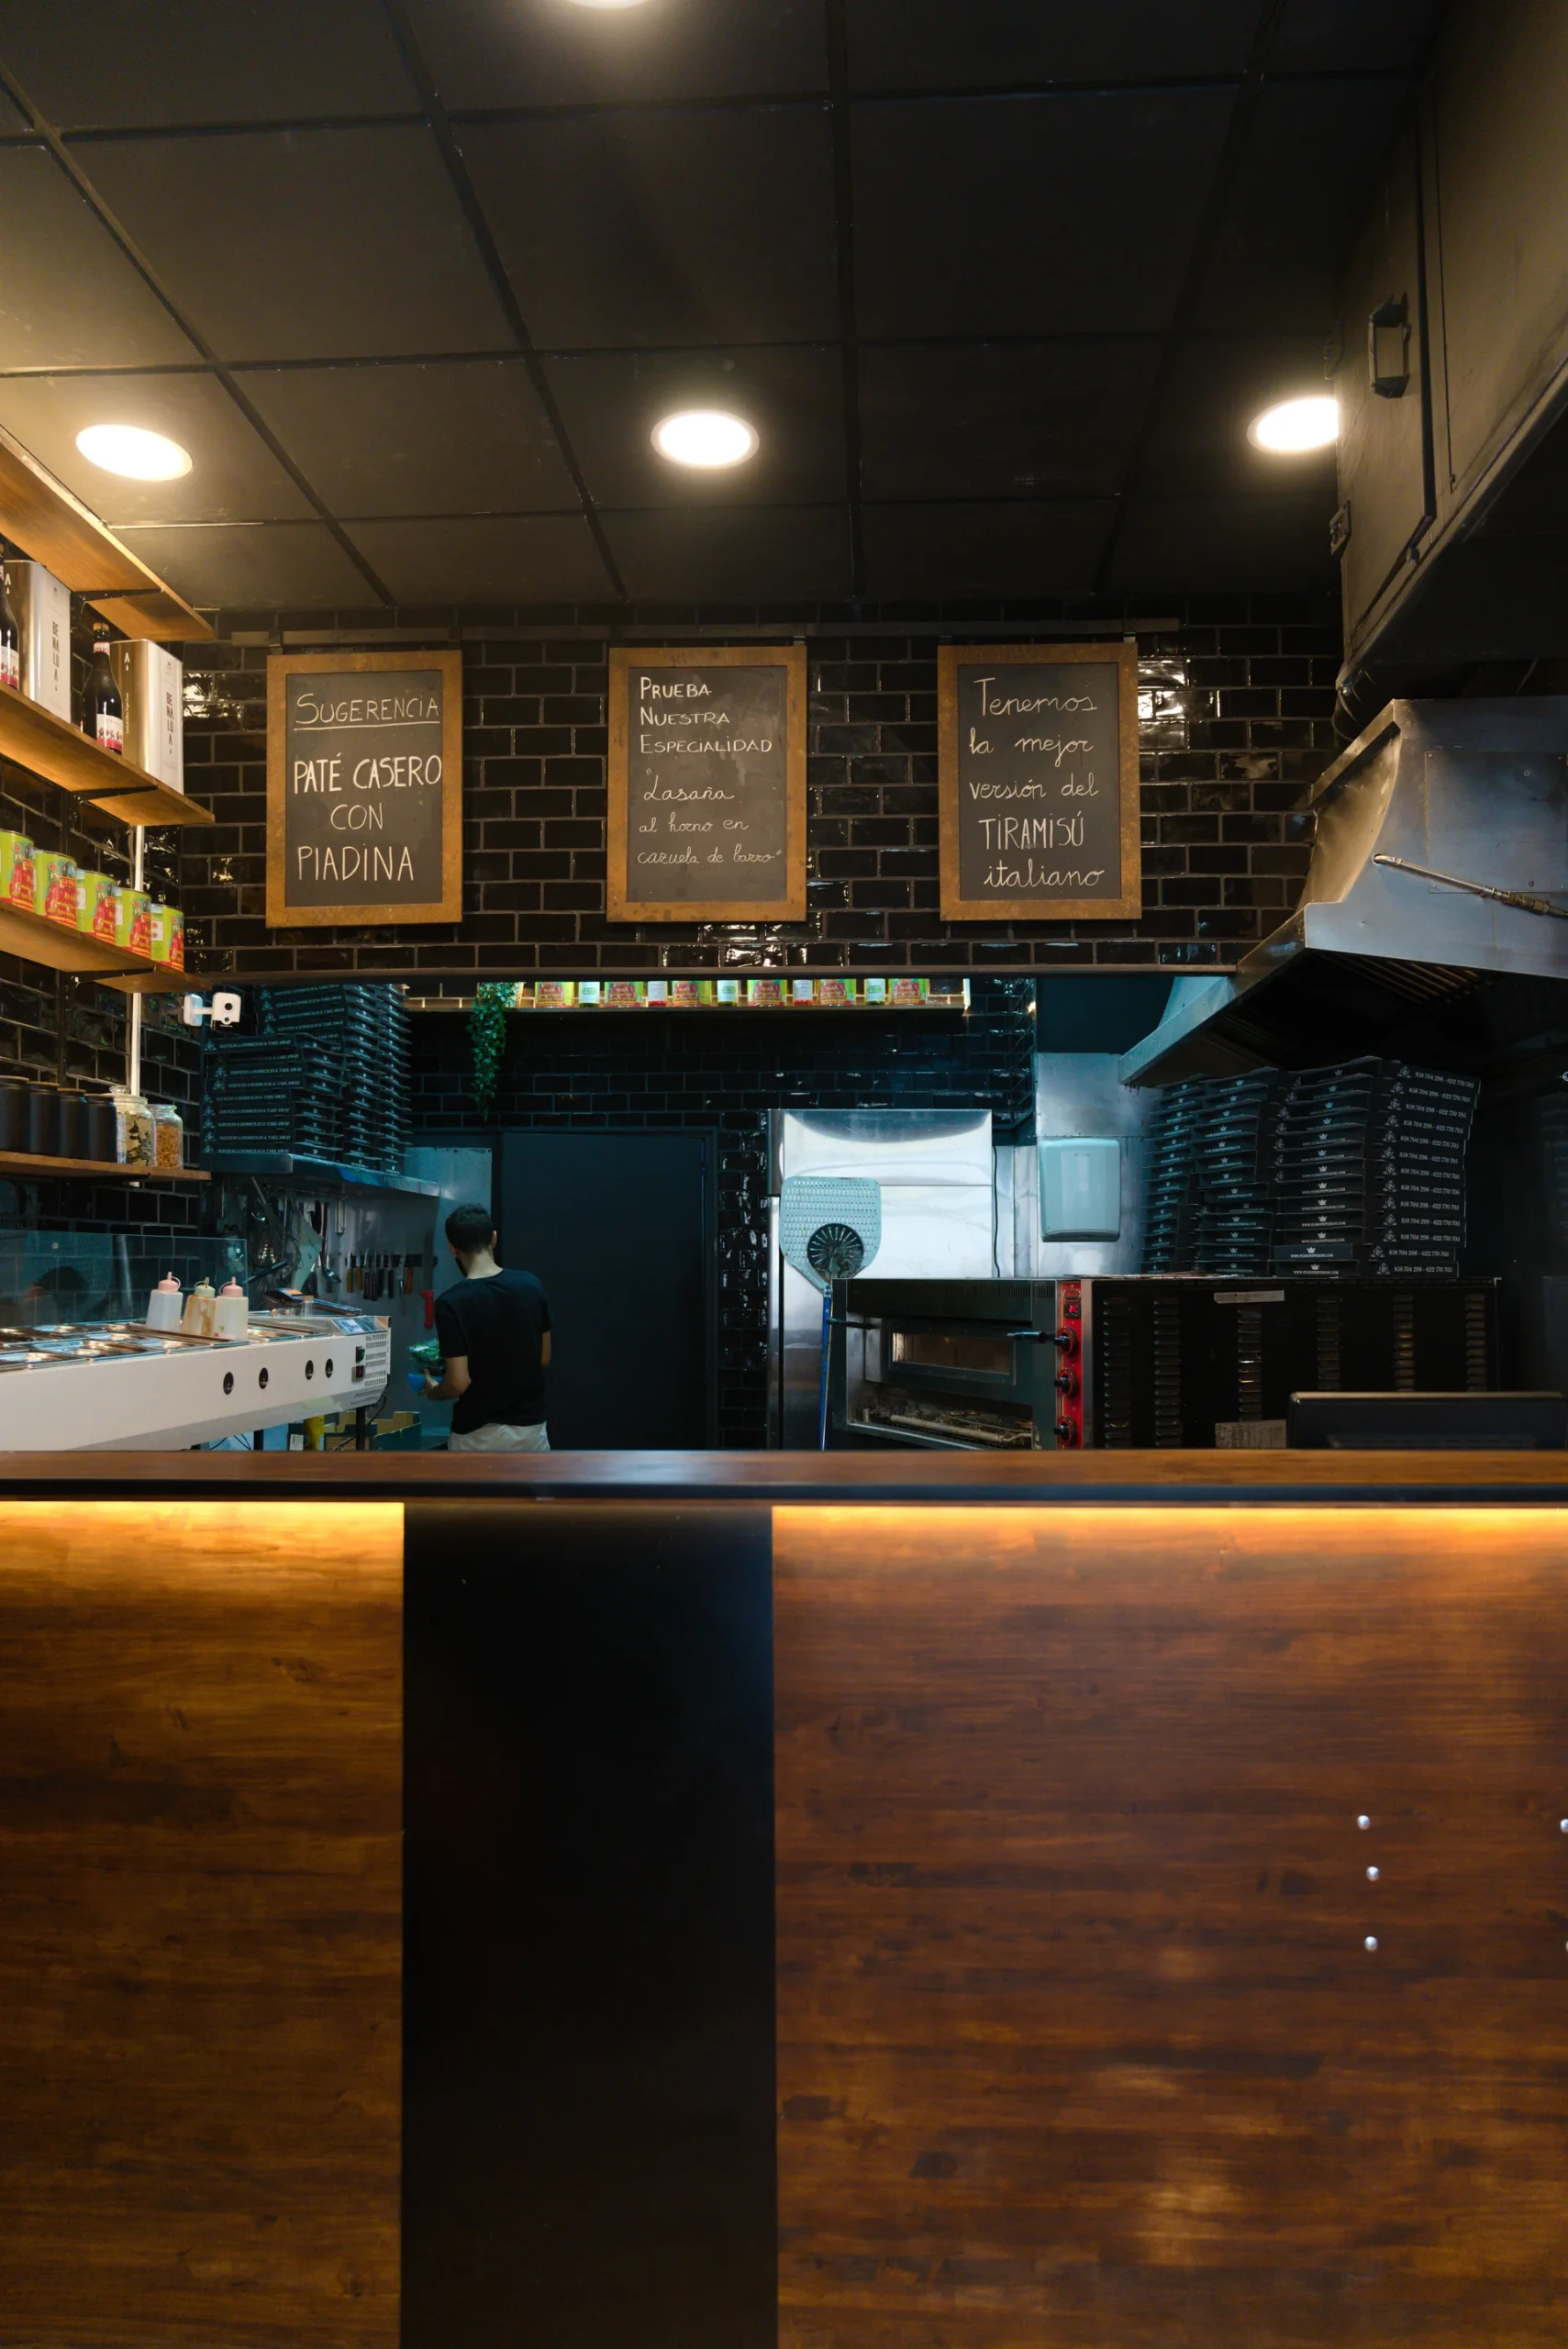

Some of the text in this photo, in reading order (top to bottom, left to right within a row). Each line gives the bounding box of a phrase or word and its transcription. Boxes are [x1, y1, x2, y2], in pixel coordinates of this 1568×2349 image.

[639, 676, 712, 700] PRUEBA
[973, 677, 1098, 717] Tenemos
[295, 693, 439, 724] SUGERENCIA
[639, 707, 729, 726] NUESTRA
[969, 727, 1094, 768] la mejor
[294, 752, 442, 795] PATÉ CASERO
[970, 773, 1099, 800] versión del
[330, 803, 383, 830] CON
[639, 812, 750, 833] al horno en
[978, 810, 1084, 850] TIRAMISÚ
[297, 843, 414, 882] PIADINA
[637, 846, 700, 864] cazuela
[707, 847, 723, 863] de
[984, 858, 1105, 888] italiano
